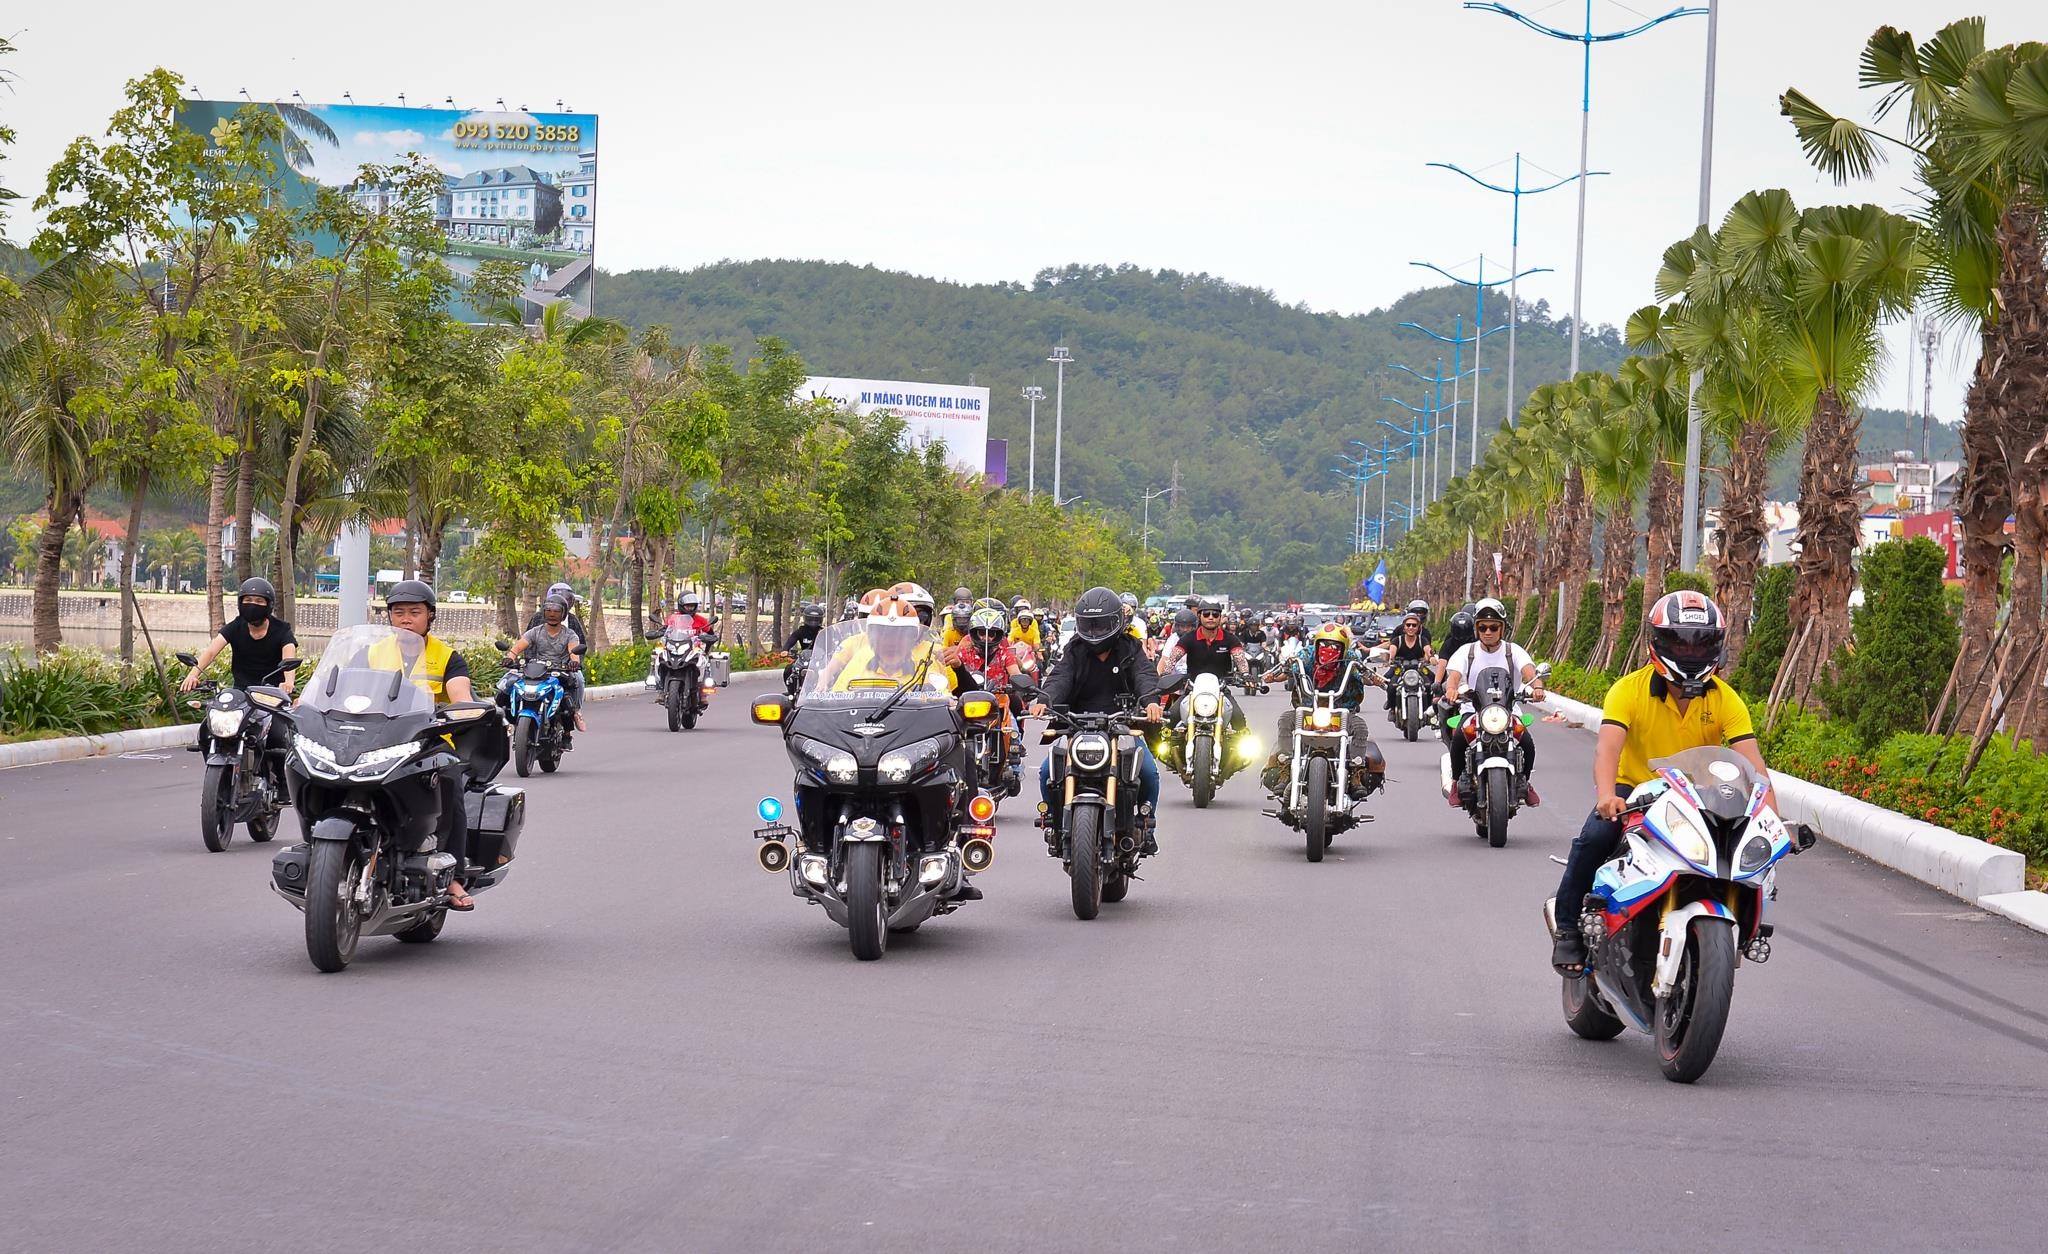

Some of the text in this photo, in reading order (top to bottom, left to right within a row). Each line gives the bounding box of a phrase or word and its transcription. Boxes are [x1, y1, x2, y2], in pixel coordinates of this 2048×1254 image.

[453, 121, 579, 142] 093 520 5858
[861, 391, 871, 404] XI
[905, 394, 937, 409] VICEM
[955, 398, 981, 411] LONG
